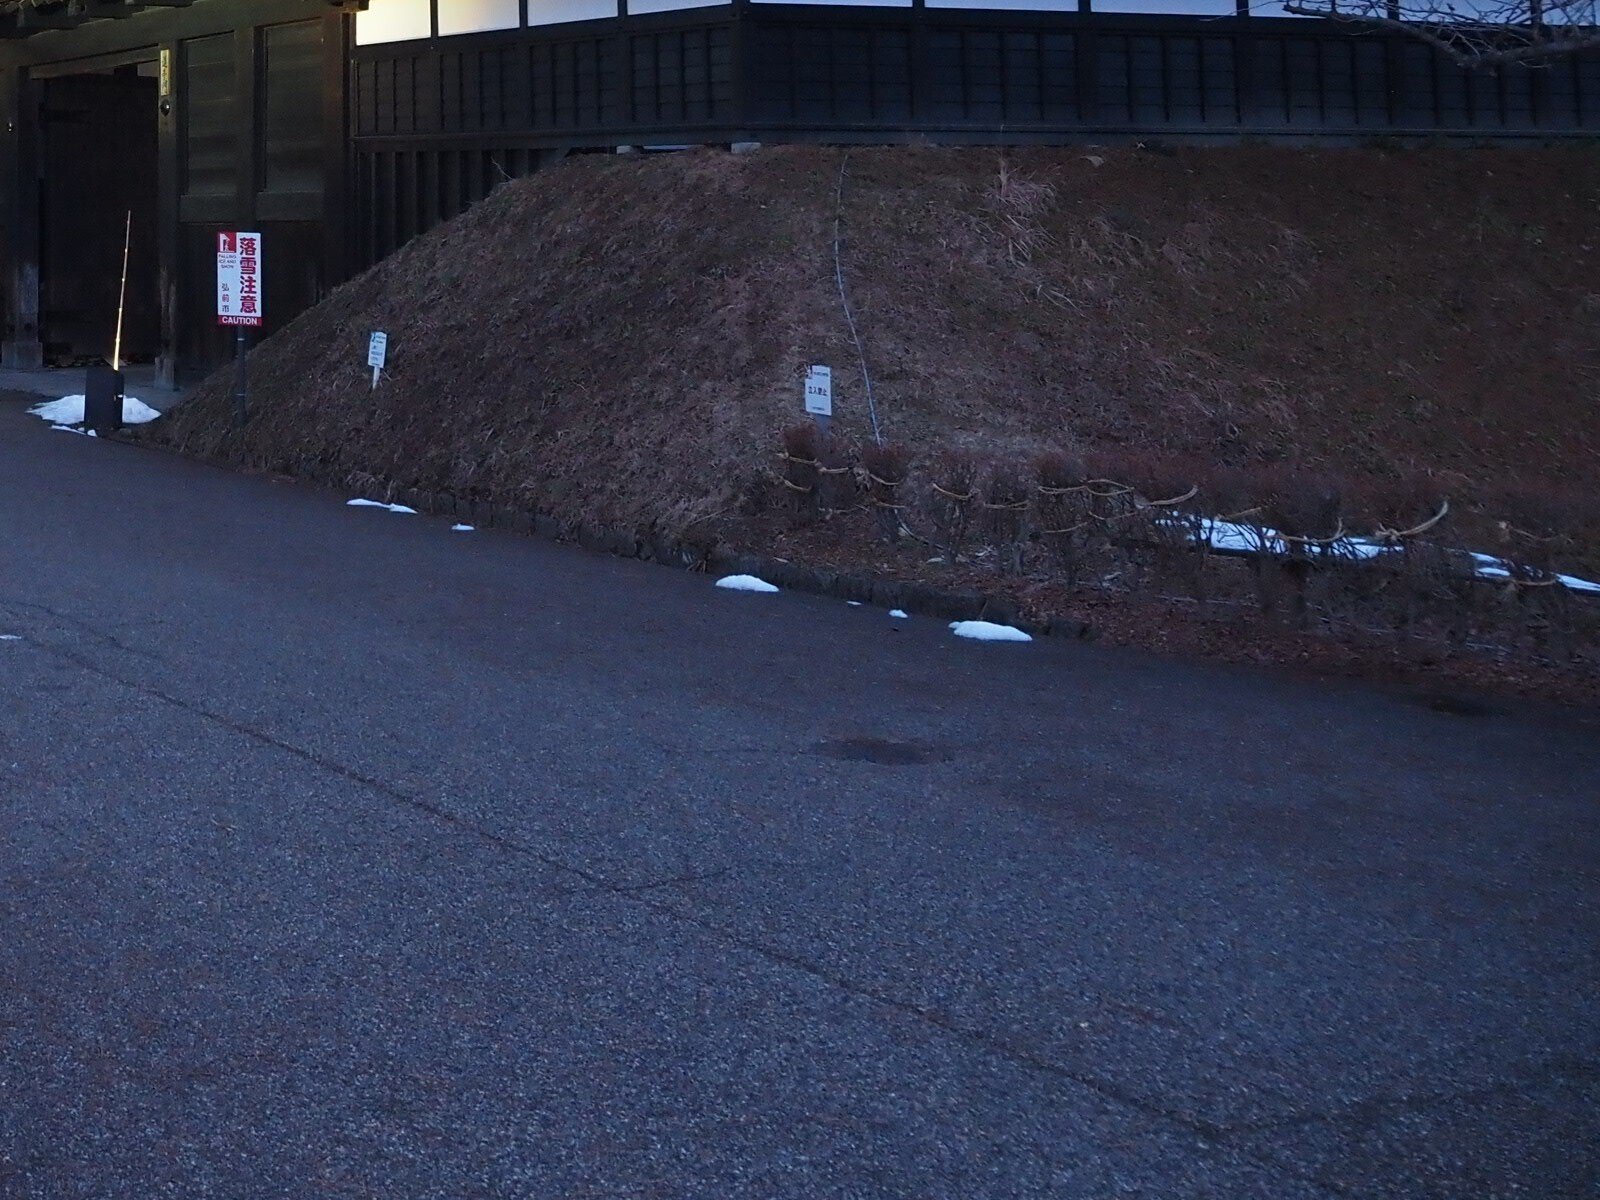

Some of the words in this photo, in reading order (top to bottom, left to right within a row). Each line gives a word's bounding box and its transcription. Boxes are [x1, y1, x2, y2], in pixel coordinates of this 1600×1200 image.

[239, 237, 257, 313] 落雪注意
[221, 283, 230, 313] 弘前市
[222, 316, 258, 325] CAUTION
